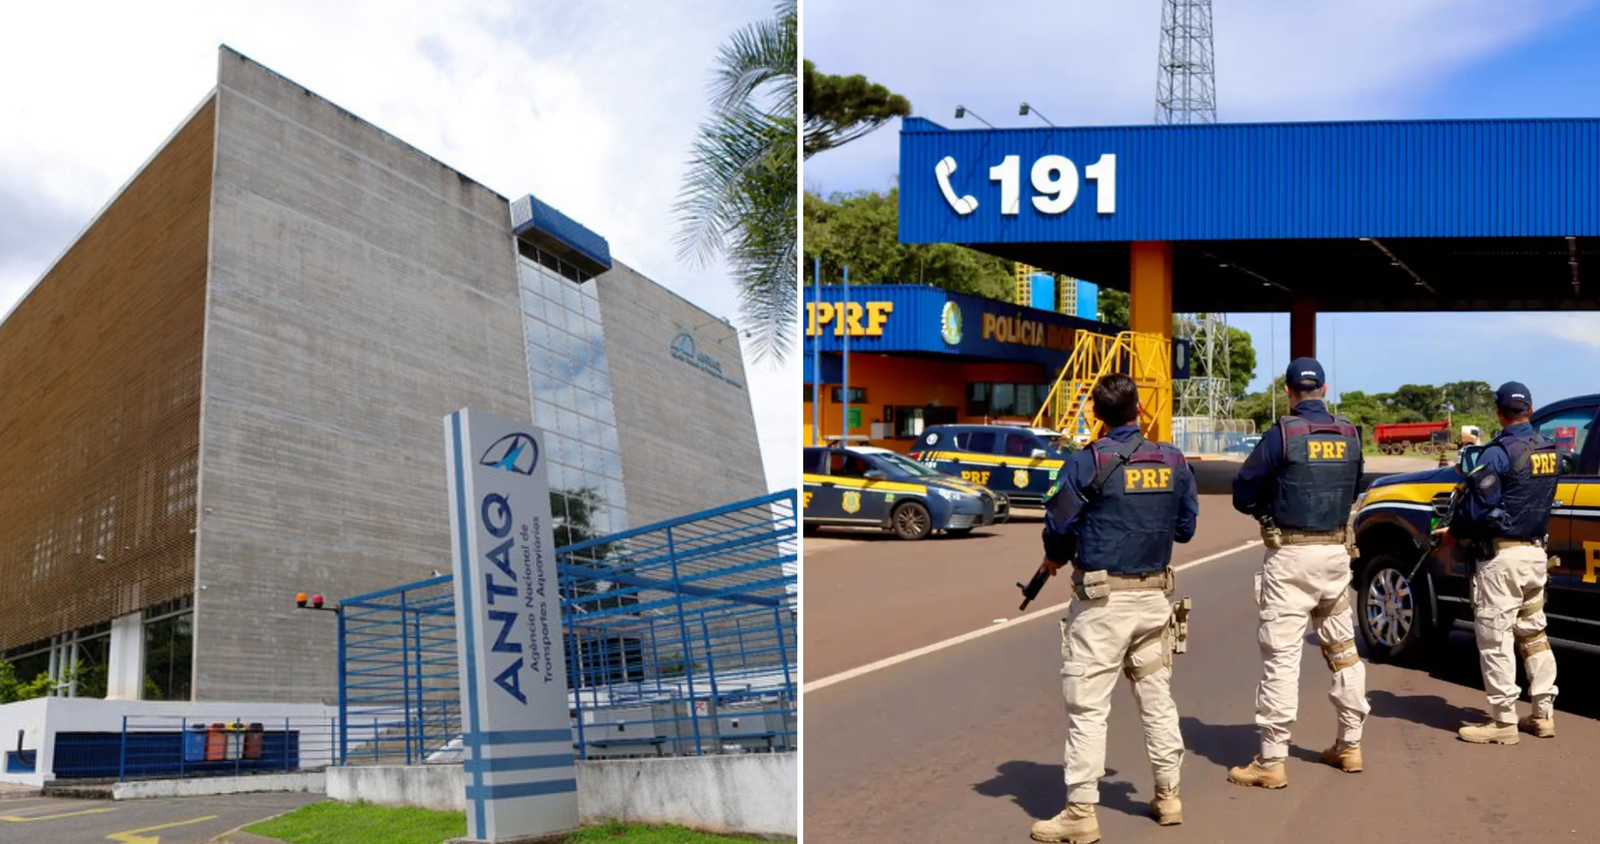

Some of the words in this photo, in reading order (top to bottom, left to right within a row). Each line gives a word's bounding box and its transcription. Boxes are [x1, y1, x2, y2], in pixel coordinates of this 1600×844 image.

[989, 153, 1116, 214] 191
[806, 302, 894, 336] PRF
[982, 311, 1046, 347] POLÍCIA
[1306, 440, 1347, 460] PRF
[1530, 452, 1557, 475] PRF
[961, 470, 990, 486] PRF
[1124, 468, 1172, 489] PRF
[520, 524, 529, 541] de
[532, 516, 546, 598] Aquaviários
[521, 545, 534, 609] Nacional
[481, 492, 527, 706] ANTAQ
[526, 613, 540, 672] Agência
[540, 601, 553, 685] Transportes
